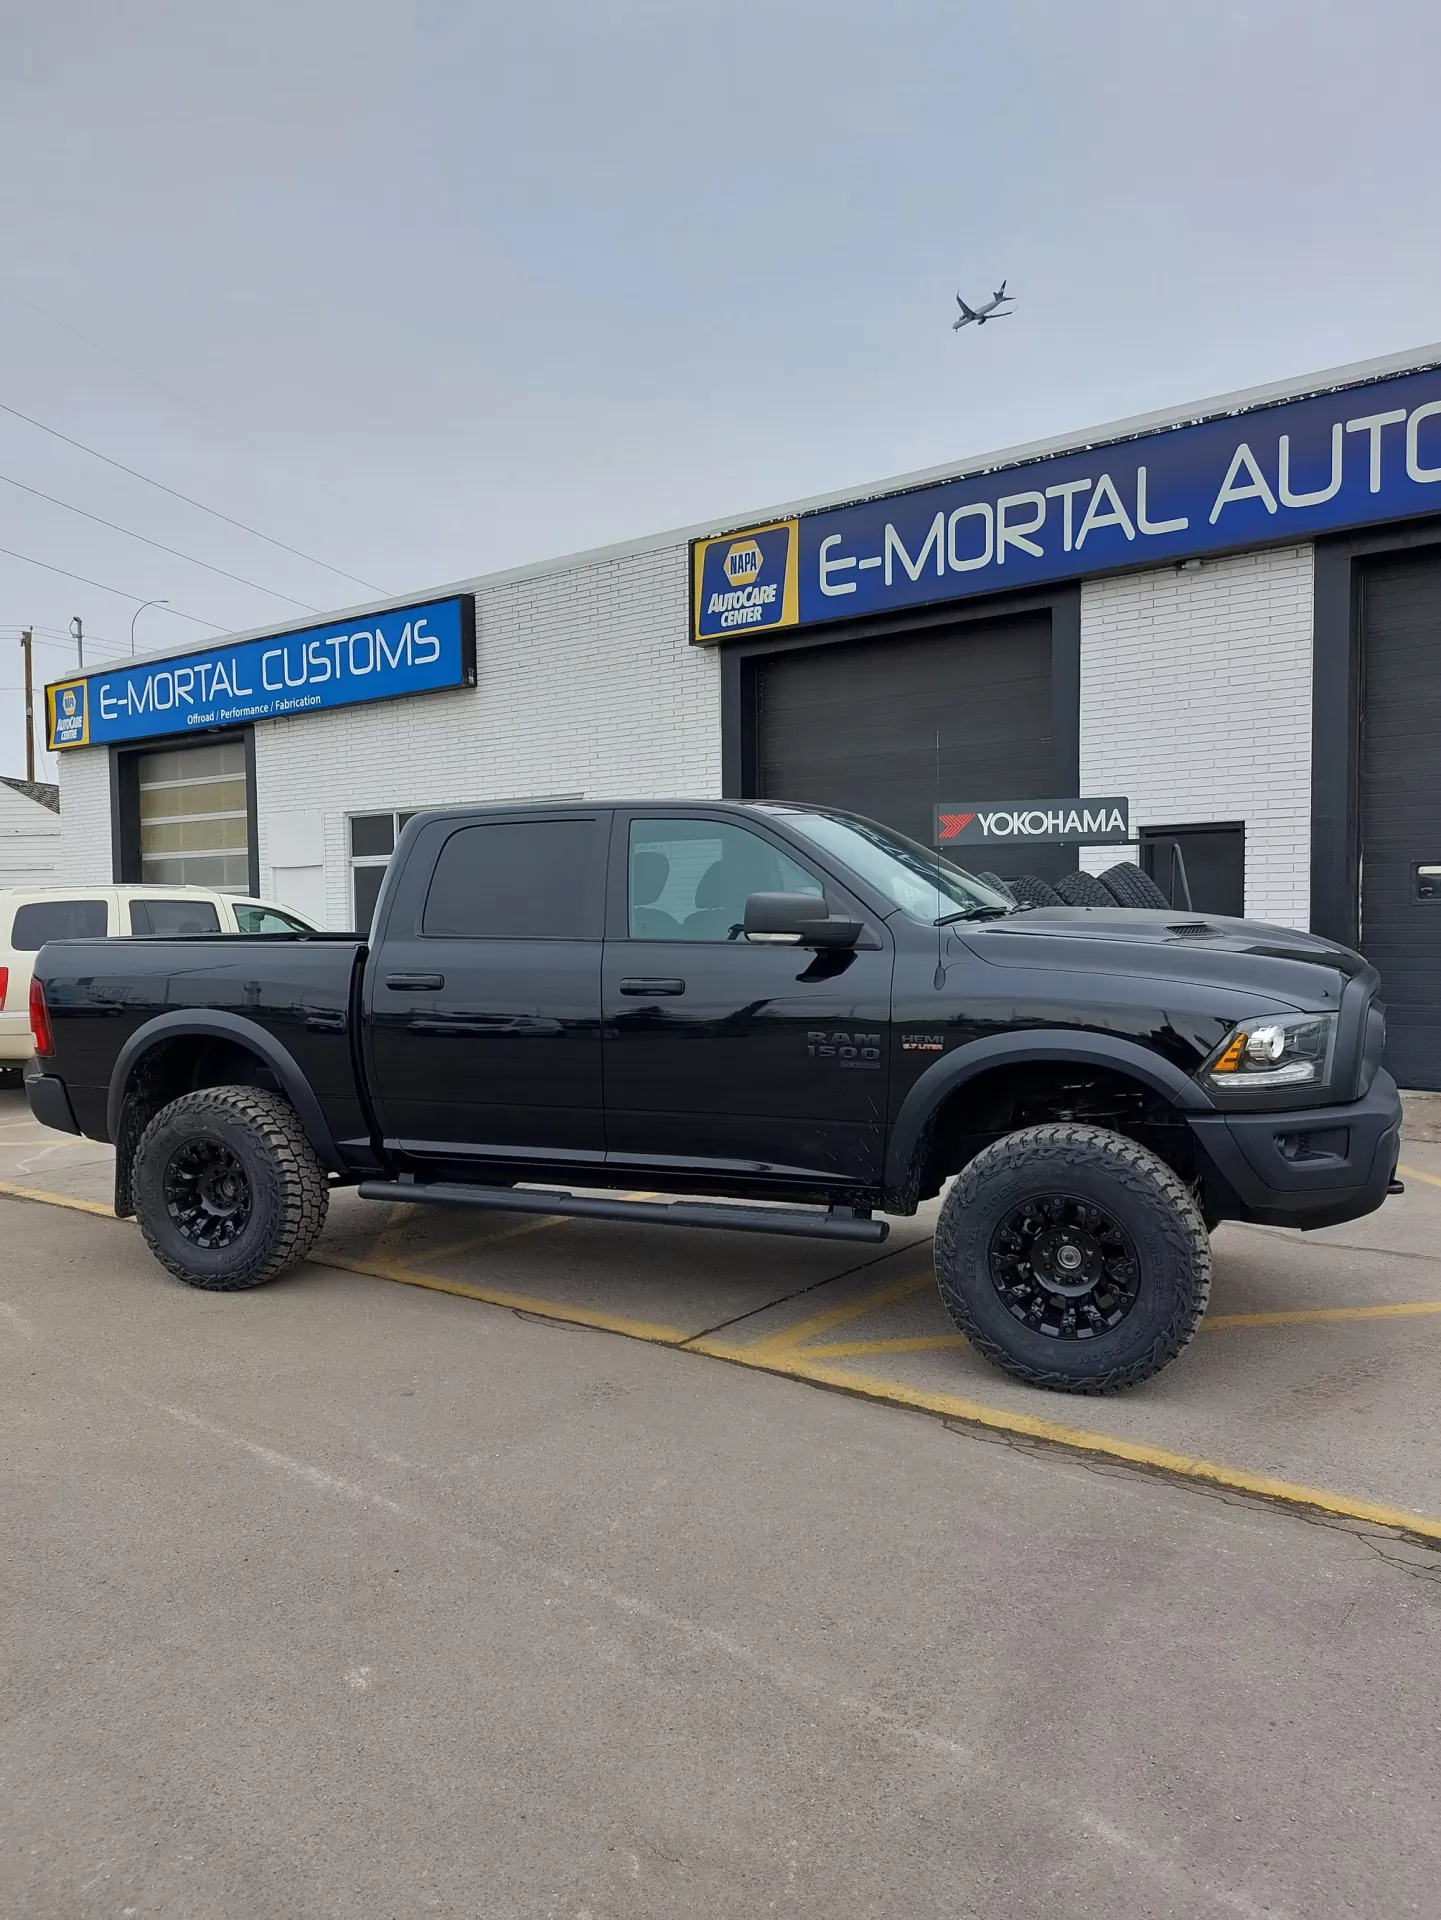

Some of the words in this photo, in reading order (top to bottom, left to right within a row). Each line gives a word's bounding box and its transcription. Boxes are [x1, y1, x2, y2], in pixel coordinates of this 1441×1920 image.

[818, 465, 1189, 597] E-MORTAL
[729, 550, 758, 576] NAPA
[720, 605, 763, 628] CENTER
[100, 658, 253, 720] E-MORTAL
[261, 618, 441, 691] CUSTOMS
[187, 711, 215, 725] Offroad
[220, 702, 269, 719] Performance
[275, 694, 322, 711] Fabrication
[977, 808, 1127, 836] YOKOHAMA
[807, 1031, 881, 1045] RAM
[901, 1035, 945, 1044] HEMI
[807, 1045, 881, 1060] 1500
